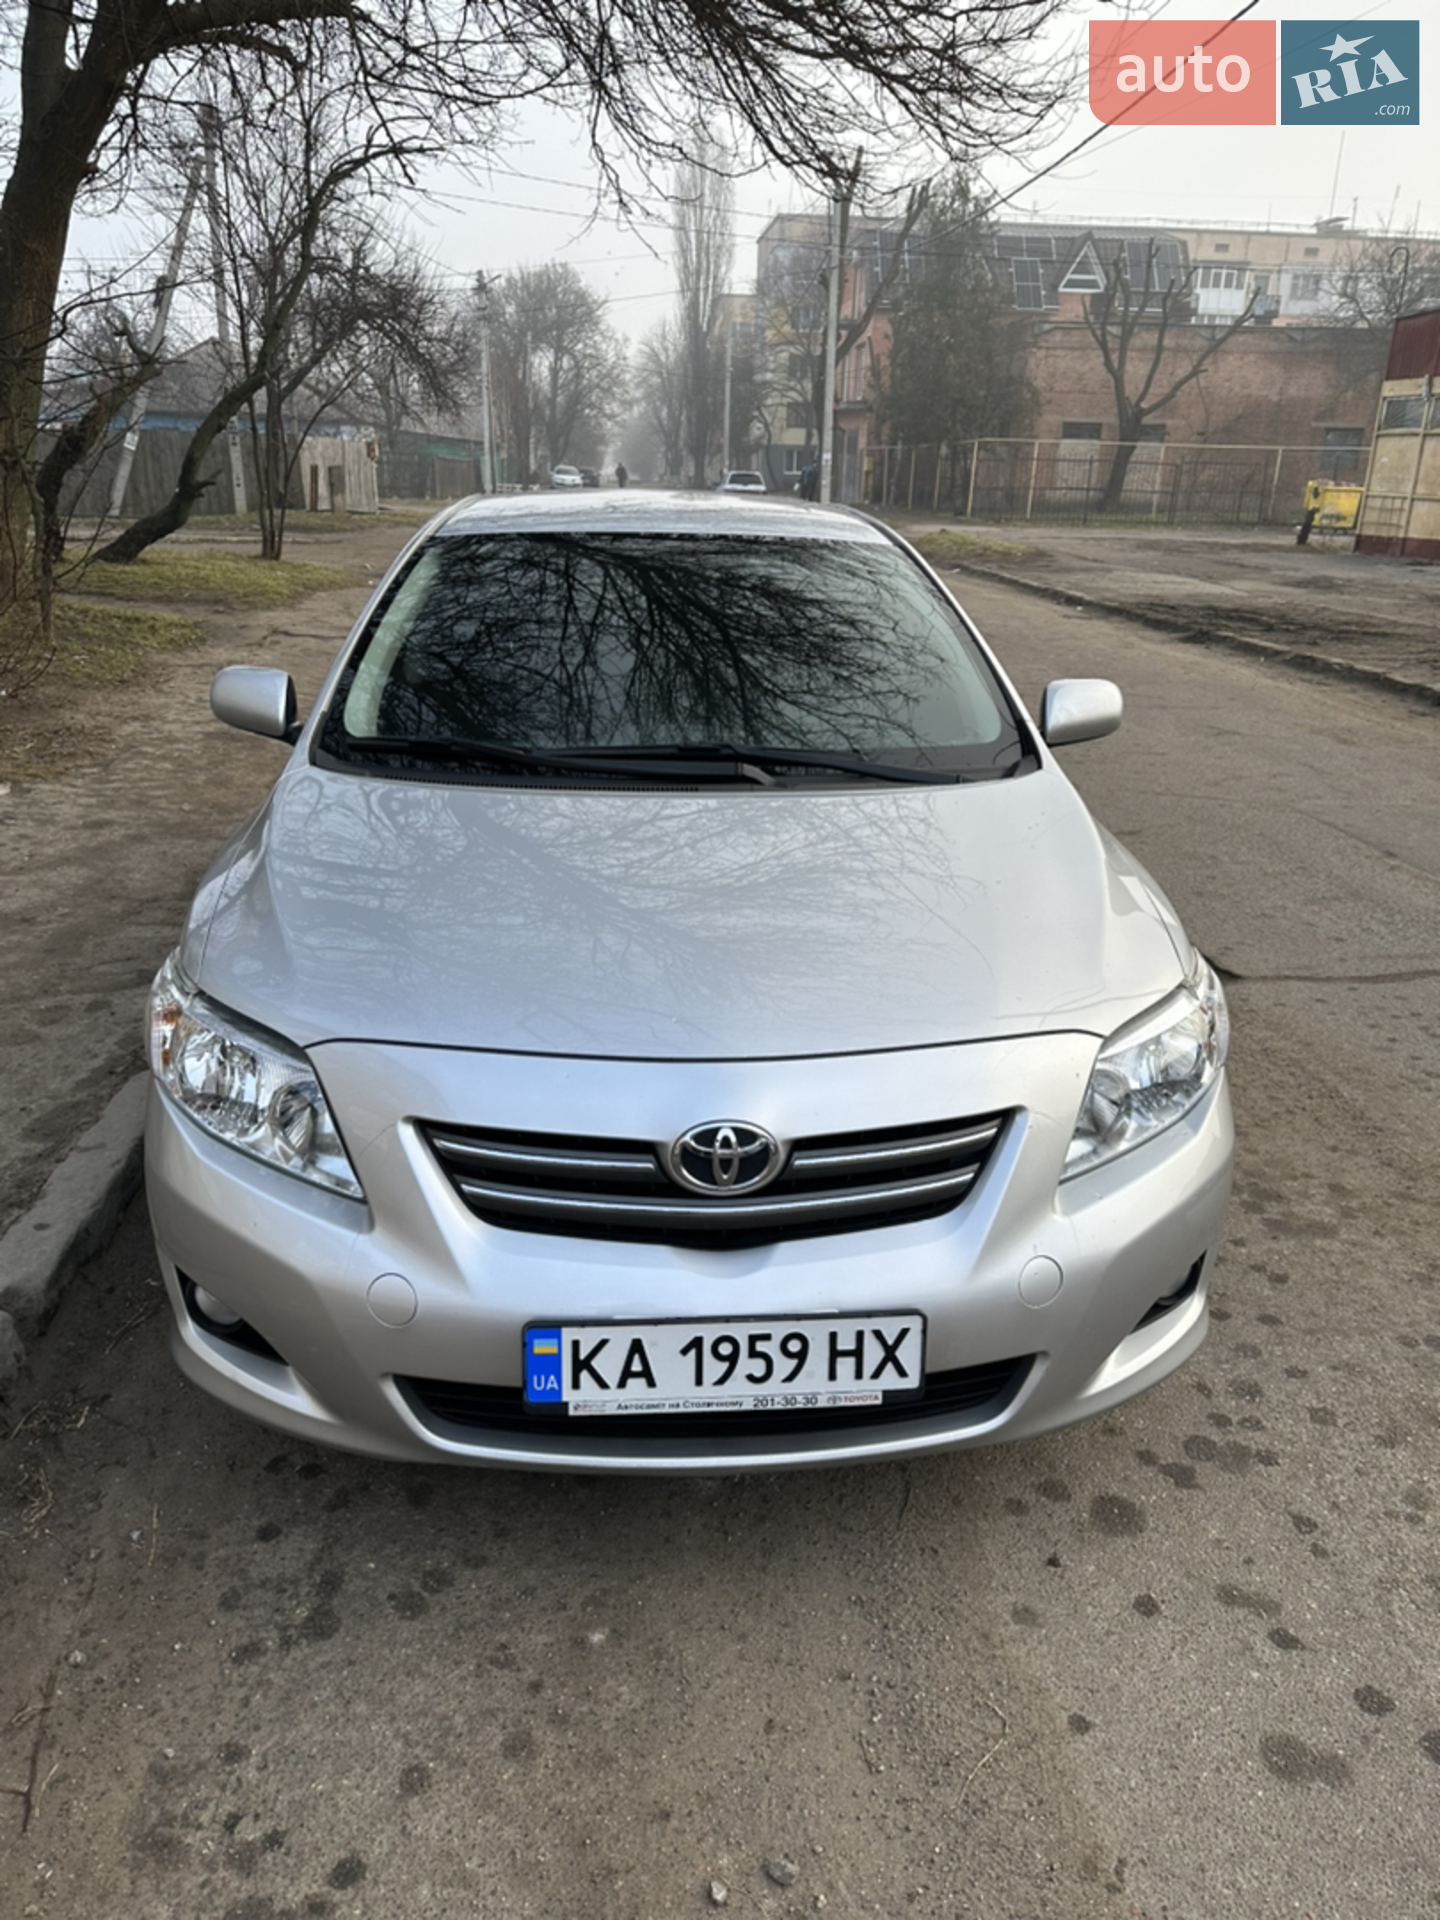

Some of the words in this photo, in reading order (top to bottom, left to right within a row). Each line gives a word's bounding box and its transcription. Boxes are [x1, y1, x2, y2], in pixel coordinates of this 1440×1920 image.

[571, 1337, 657, 1390] KA
[680, 1331, 810, 1387] 1959
[827, 1327, 911, 1382] HX
[533, 1374, 559, 1391] UA
[753, 1394, 818, 1408] 201-30-30
[843, 1394, 879, 1404] TOYOTA
